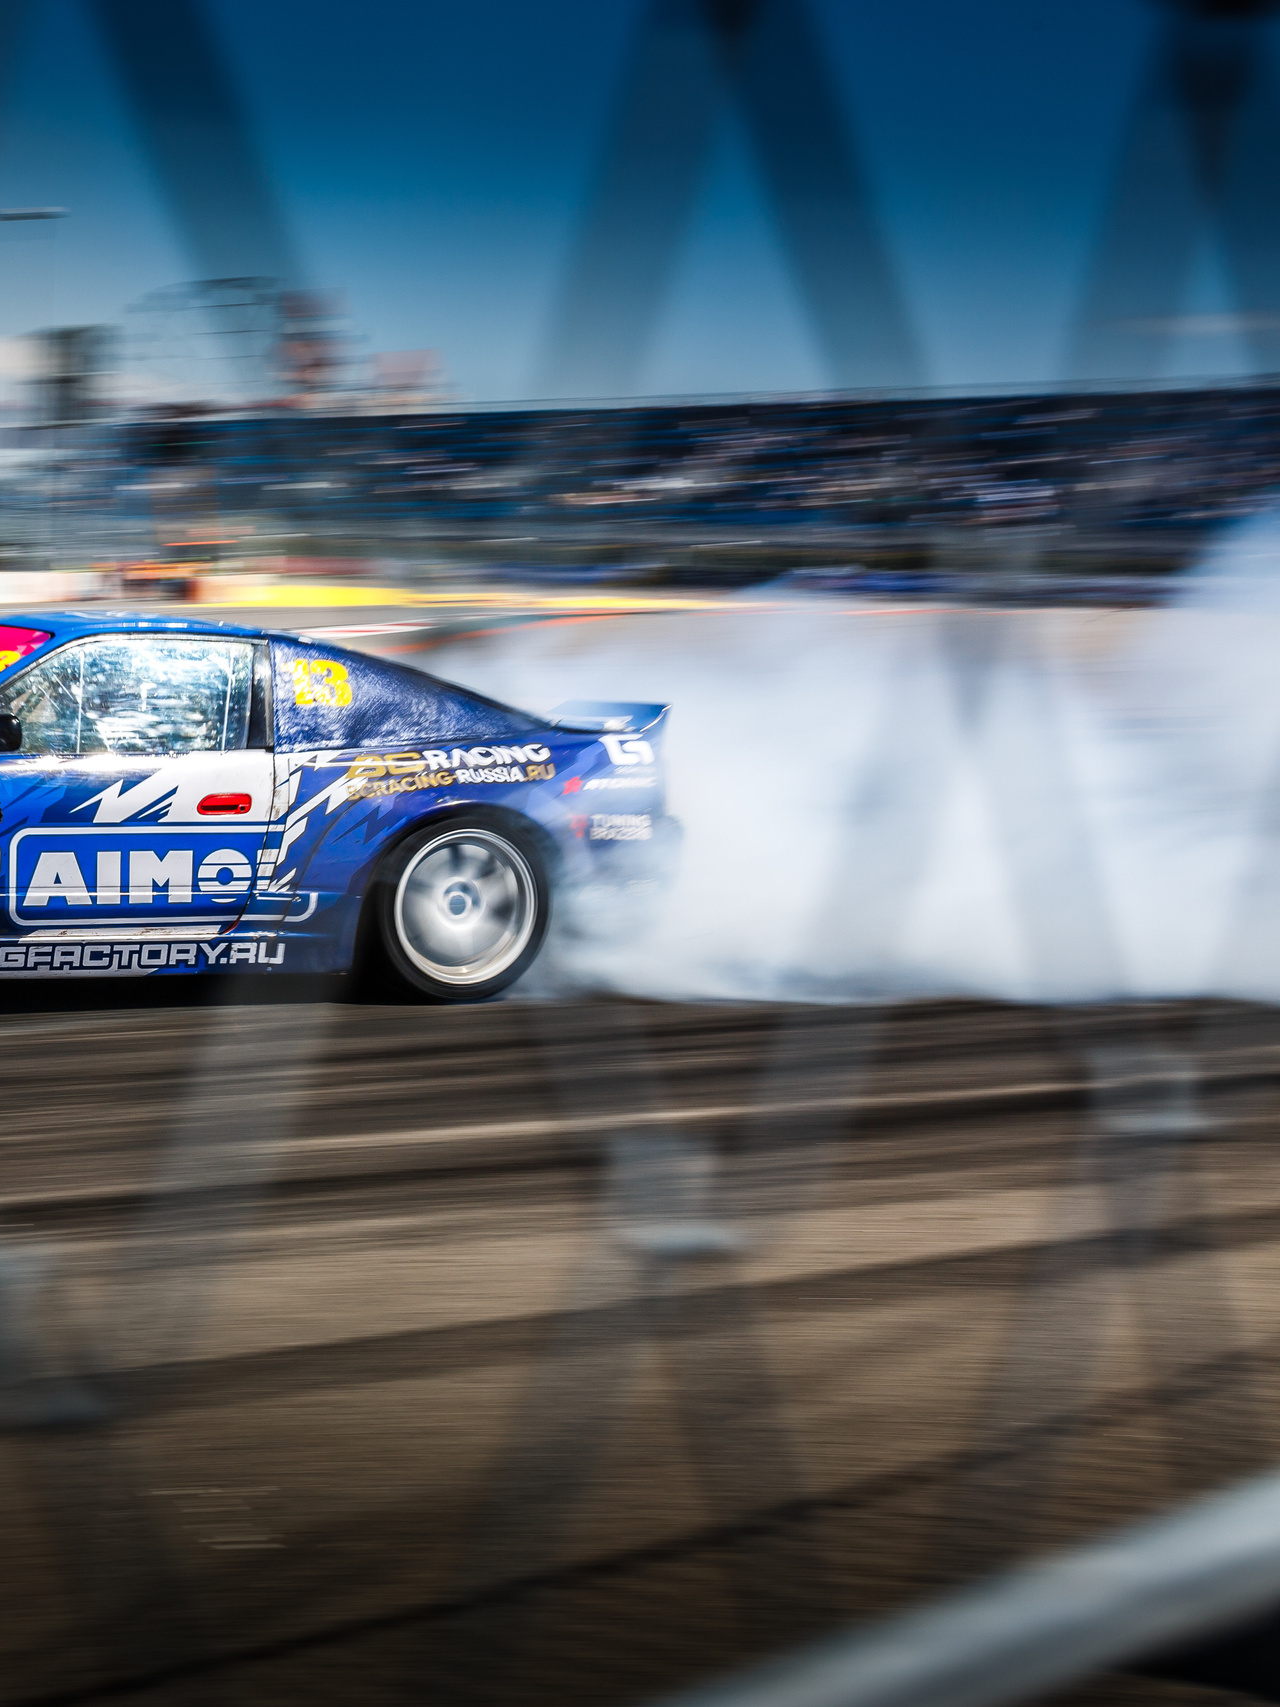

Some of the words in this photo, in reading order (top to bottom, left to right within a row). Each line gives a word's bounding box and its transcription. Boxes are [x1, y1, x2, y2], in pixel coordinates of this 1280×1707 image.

[281, 658, 353, 708] 13
[422, 743, 552, 771] RACING
[22, 848, 293, 905] AIMOL
